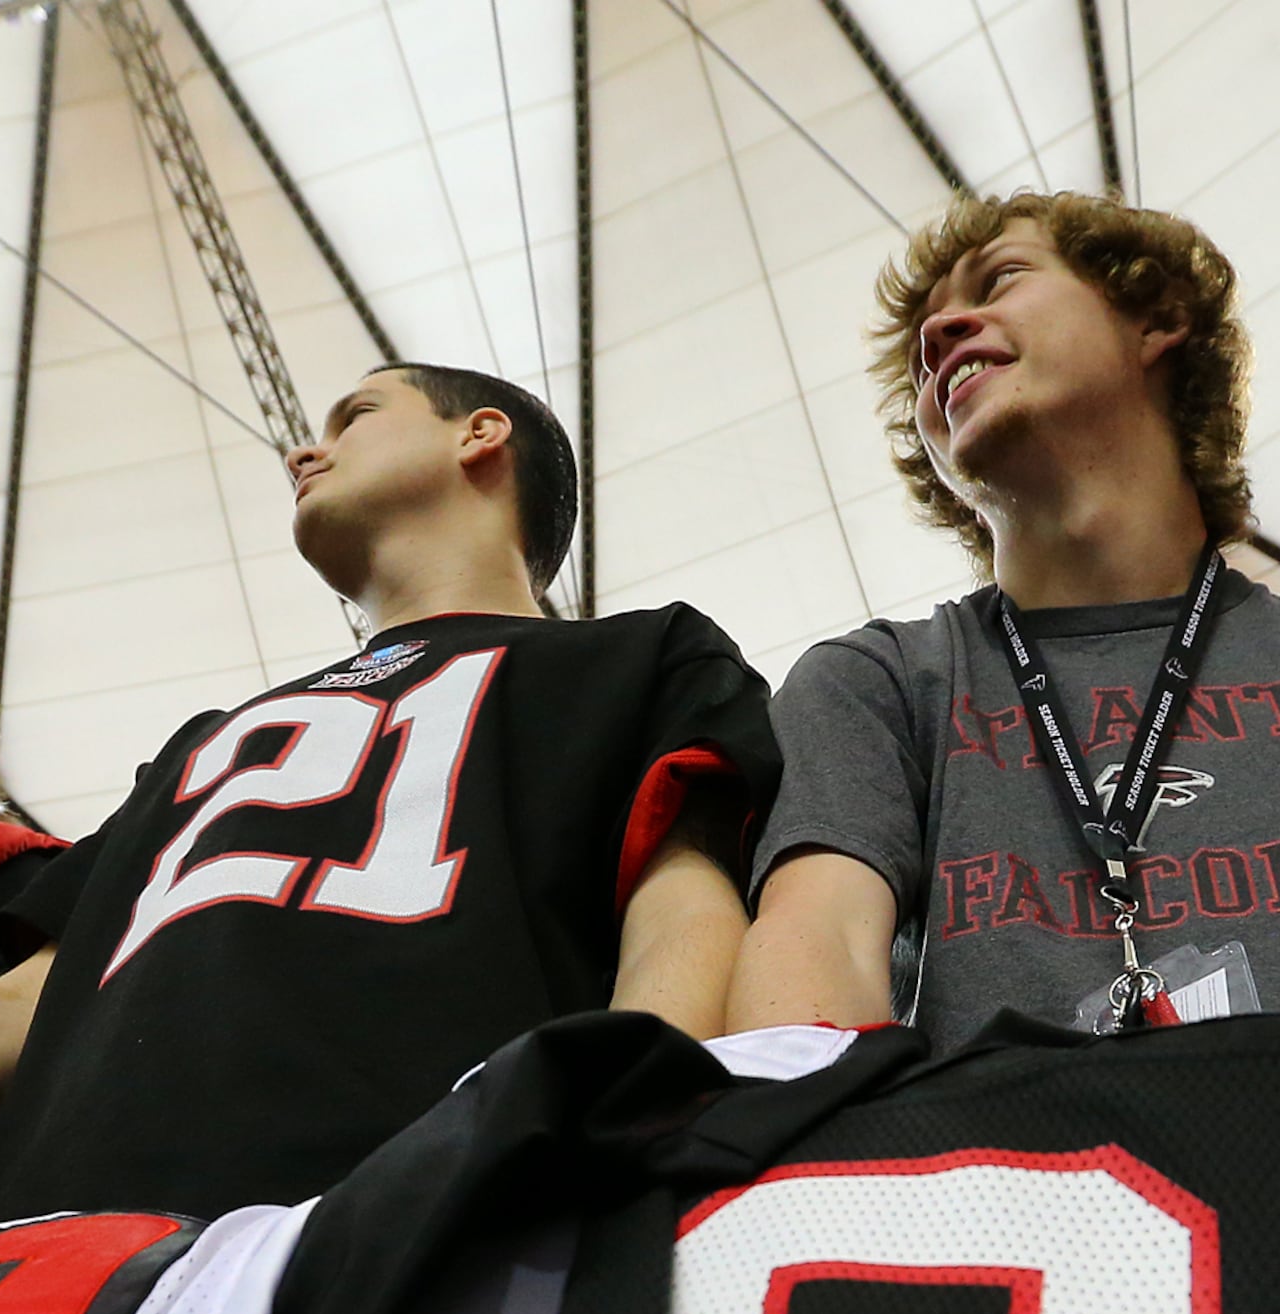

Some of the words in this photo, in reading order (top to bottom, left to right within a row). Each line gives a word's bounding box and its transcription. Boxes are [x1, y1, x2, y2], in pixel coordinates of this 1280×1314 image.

[1181, 611, 1200, 648] SEASON
[1038, 703, 1062, 744] SEASON
[1051, 737, 1075, 776] TICKET
[1065, 769, 1090, 808] HOLDER
[1124, 766, 1146, 812] SEASON
[1138, 731, 1160, 771] TICKET
[1151, 690, 1174, 735] HOLDER
[99, 646, 507, 991] 21
